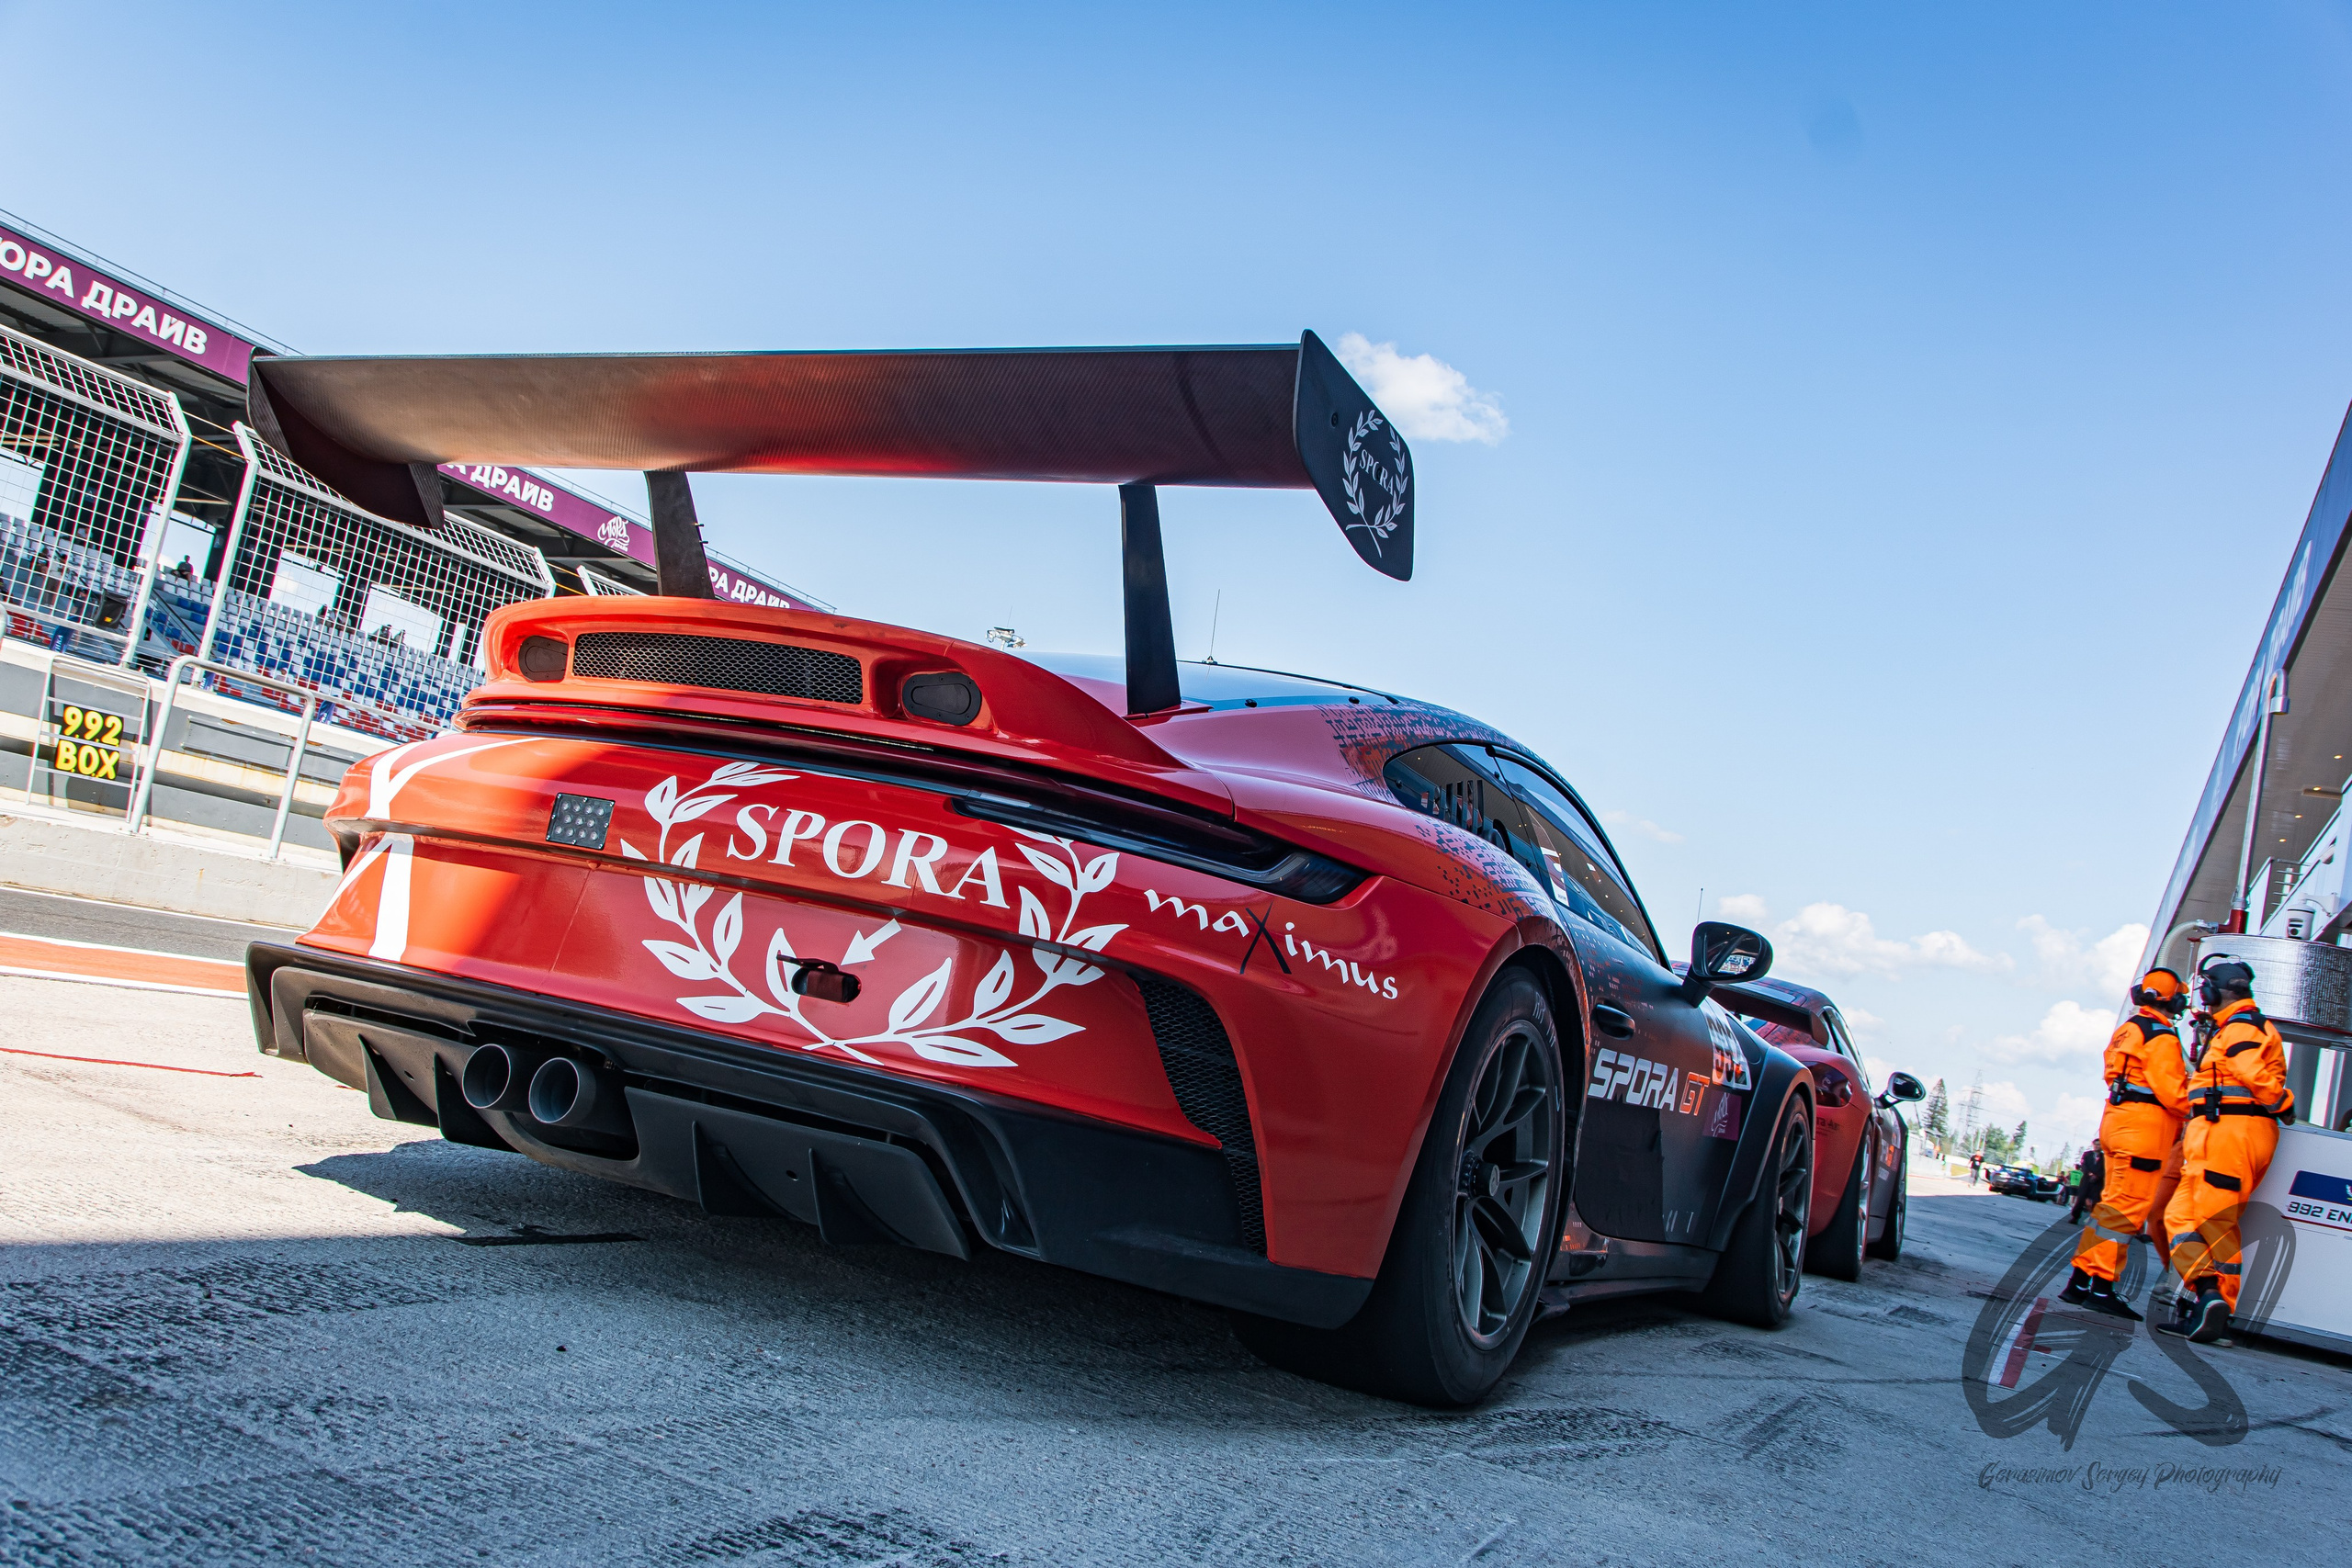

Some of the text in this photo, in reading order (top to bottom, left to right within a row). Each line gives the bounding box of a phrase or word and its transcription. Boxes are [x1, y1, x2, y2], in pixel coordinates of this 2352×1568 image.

[0, 235, 208, 355] ОРА ДРАЙВ
[469, 465, 555, 513] ДРАЙВ
[63, 706, 123, 747] 992
[55, 740, 120, 780] BOX
[726, 803, 1012, 909] SPORA
[1588, 1047, 1679, 1111] SPORA
[1679, 1071, 1711, 1116] GT
[2287, 1201, 2352, 1224] 992 EN
